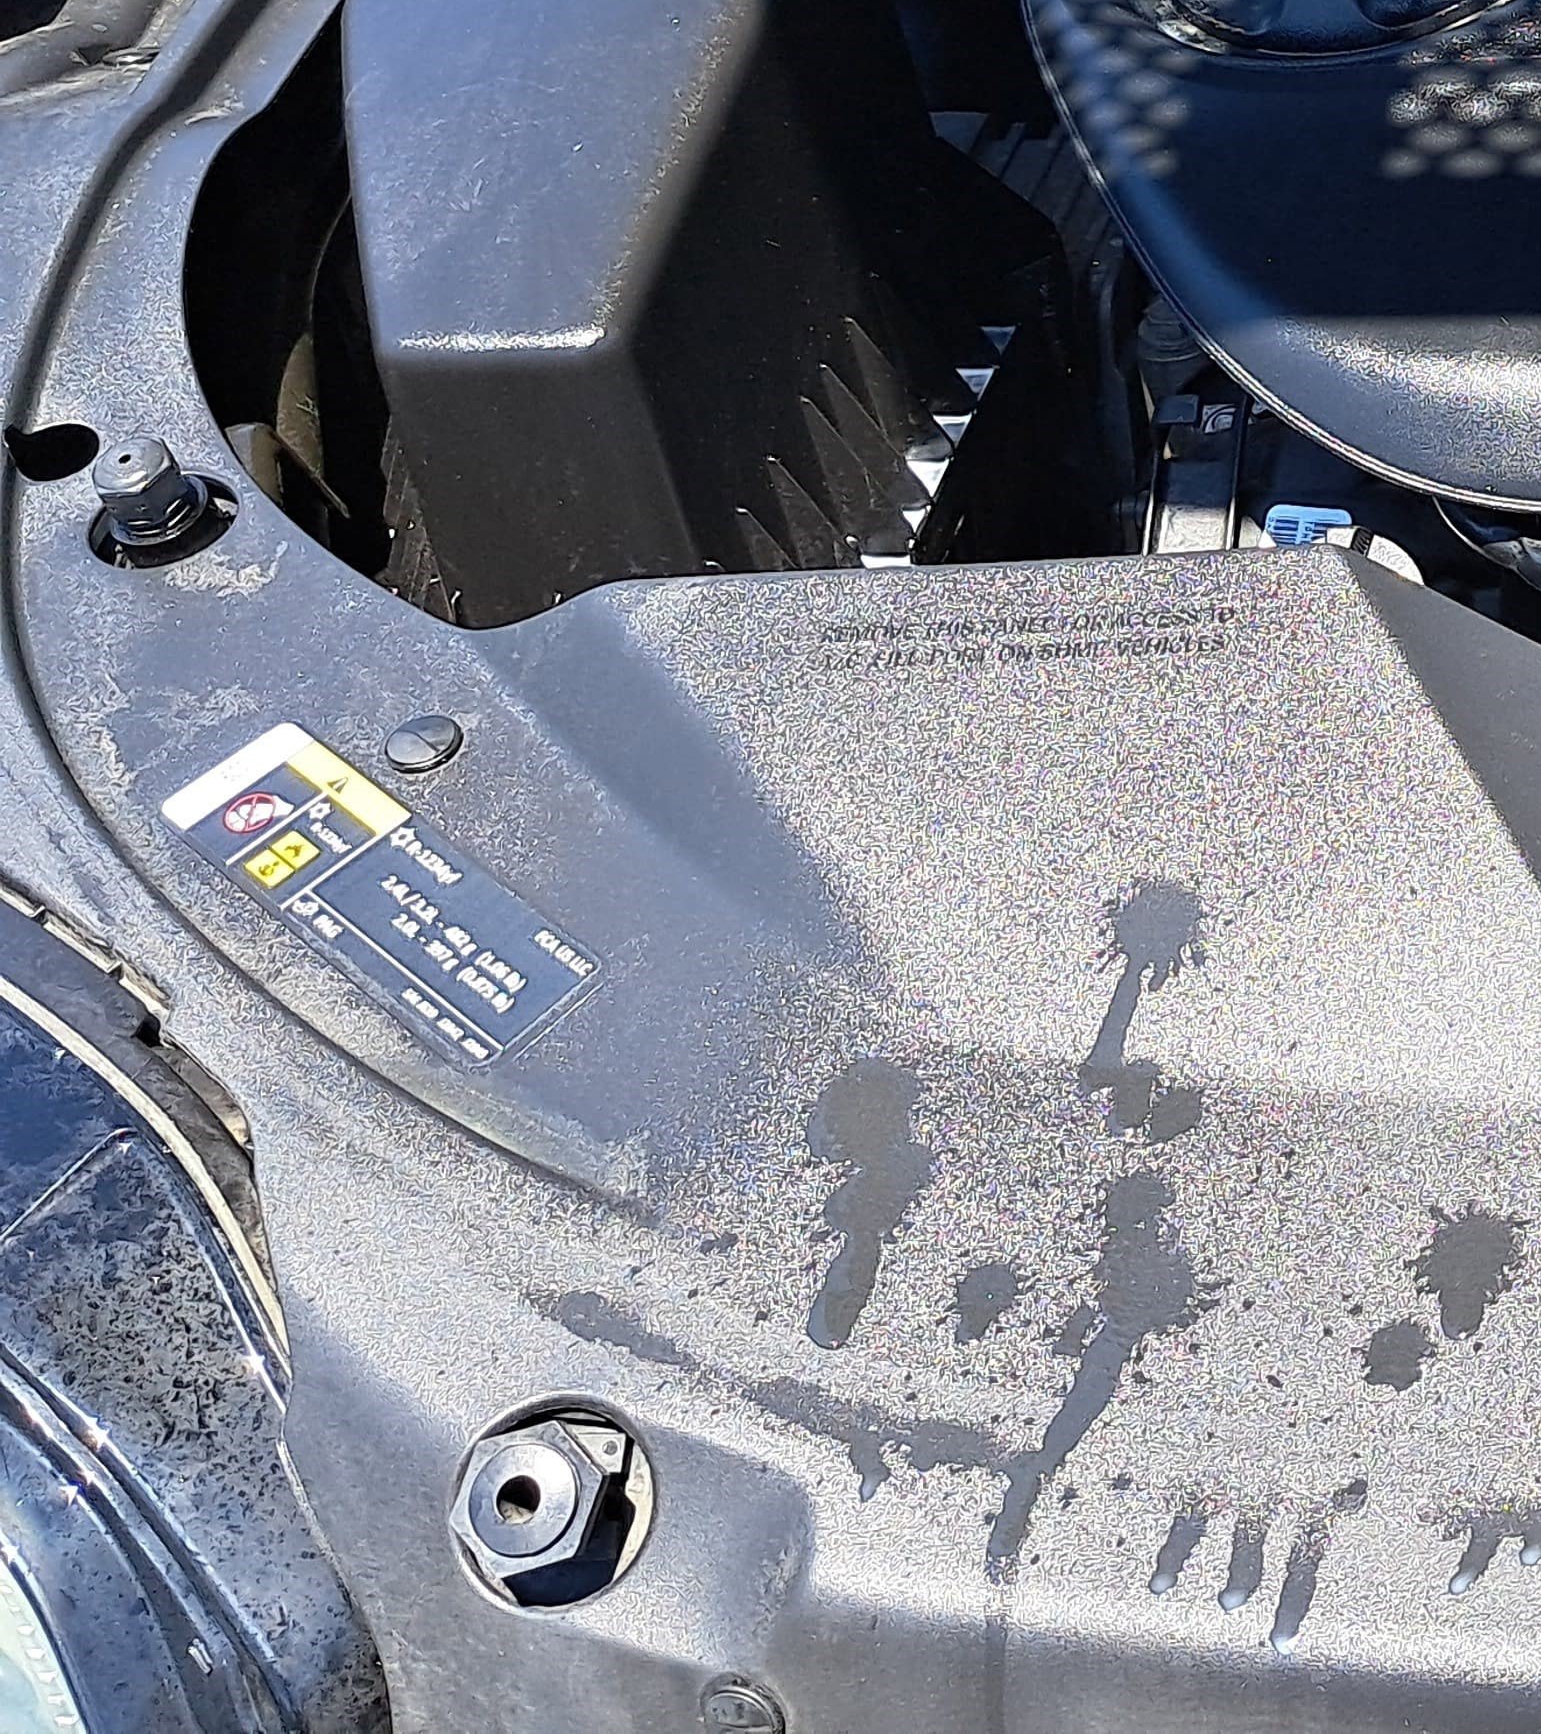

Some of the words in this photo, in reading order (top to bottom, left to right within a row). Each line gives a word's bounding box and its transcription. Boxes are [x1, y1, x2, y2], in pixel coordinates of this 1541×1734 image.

[1203, 603, 1236, 625] TO
[997, 642, 1034, 663] ON
[312, 914, 345, 939] PAG
[534, 930, 561, 953] FCA
